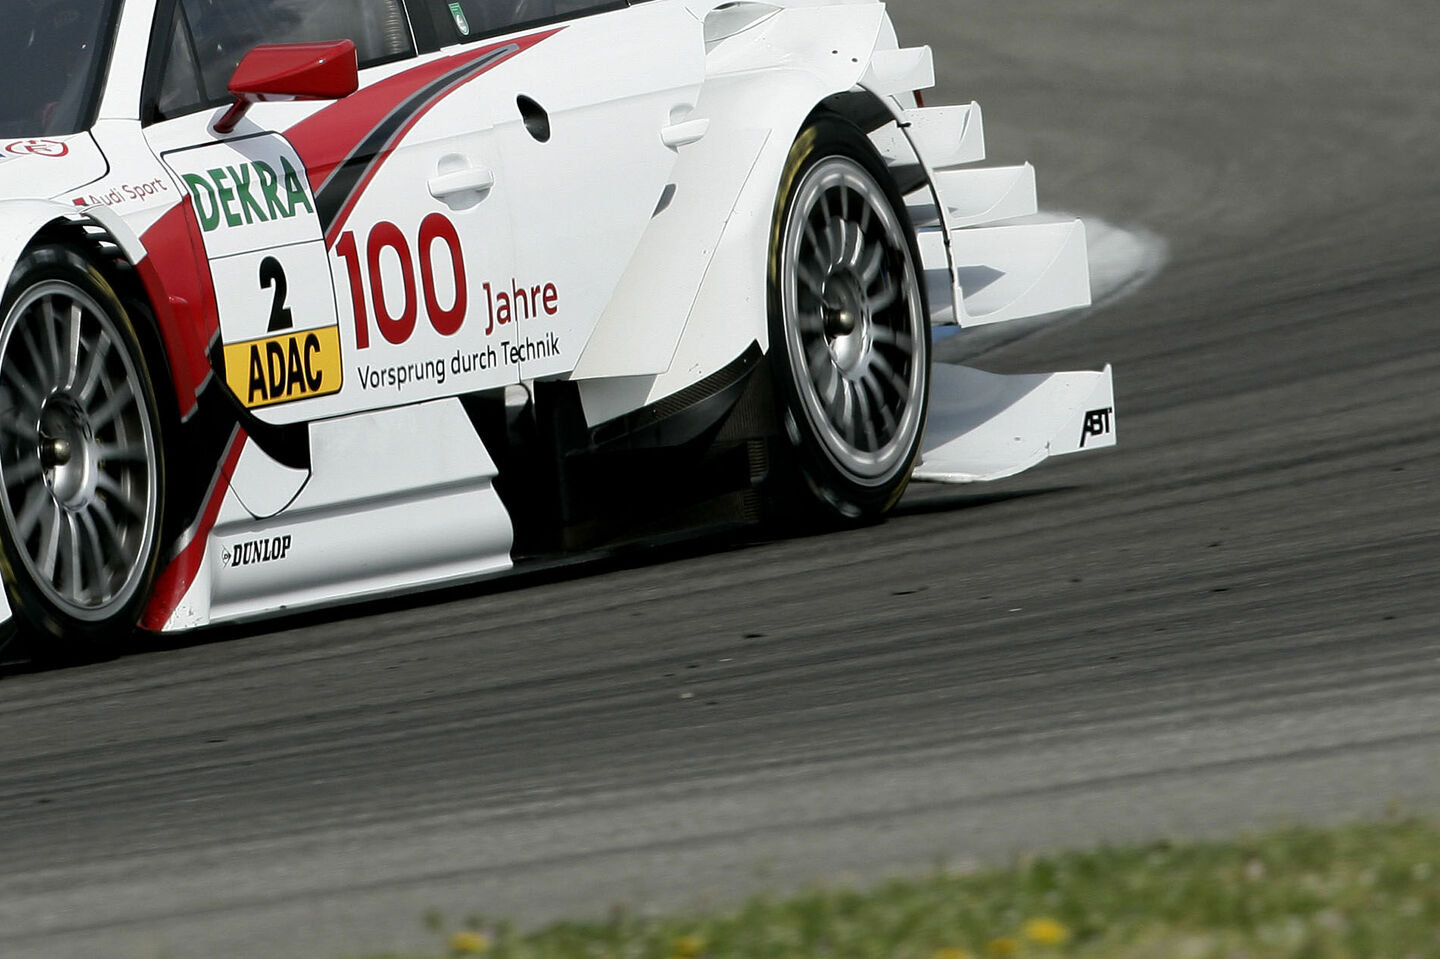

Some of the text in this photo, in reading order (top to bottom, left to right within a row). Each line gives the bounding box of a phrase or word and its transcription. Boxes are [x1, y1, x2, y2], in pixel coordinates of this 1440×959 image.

[88, 177, 168, 207] Audi Sport
[182, 154, 314, 232] DEKRA
[259, 255, 295, 333] 2
[334, 212, 560, 351] 100 Jahre
[247, 333, 323, 404] ADAC
[357, 332, 561, 391] Vorsprung durch Technik
[1079, 406, 1113, 448] ABT
[231, 534, 292, 567] DUNLOP
